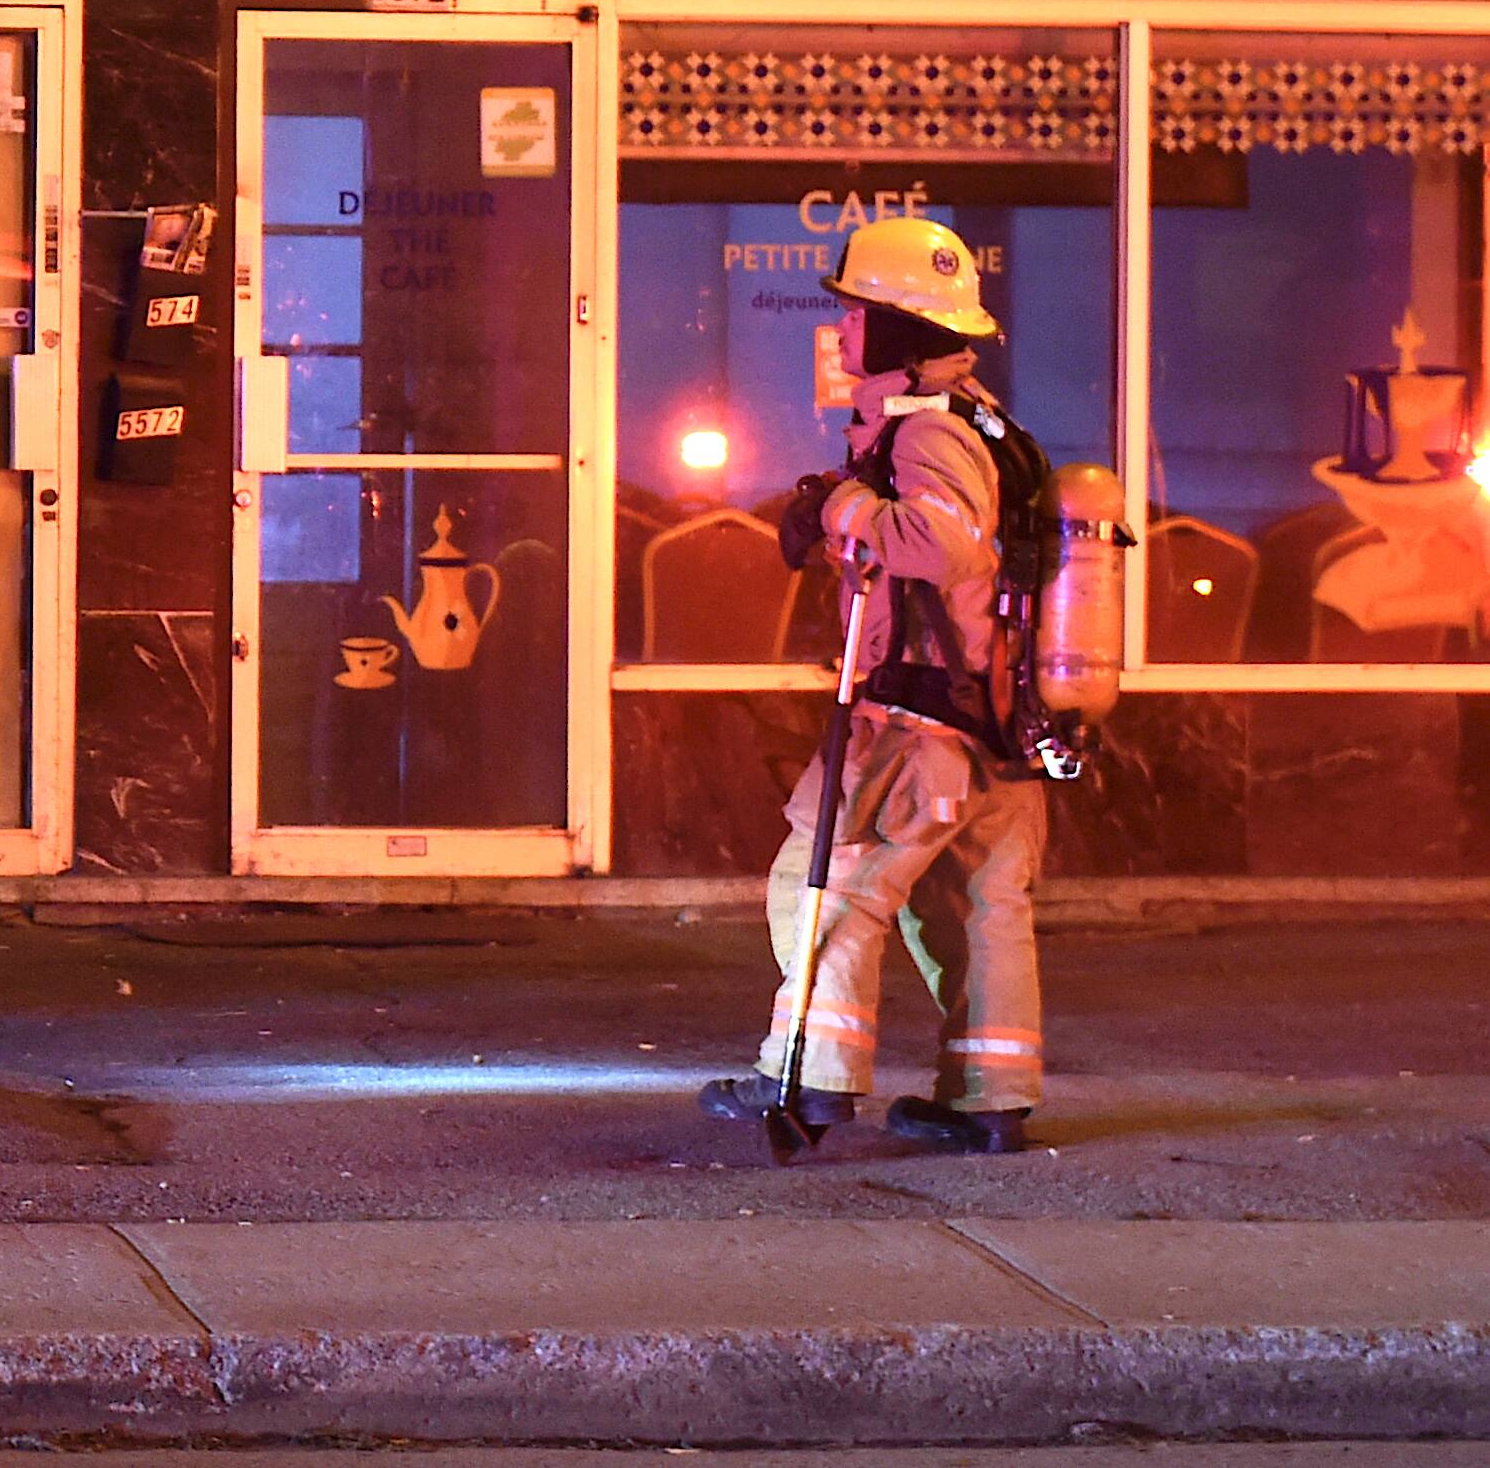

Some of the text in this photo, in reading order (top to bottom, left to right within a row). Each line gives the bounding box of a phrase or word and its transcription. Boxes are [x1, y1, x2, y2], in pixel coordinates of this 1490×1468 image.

[799, 181, 928, 233] CAFÉ
[724, 243, 830, 272] PETITE
[120, 409, 181, 437] 5572
